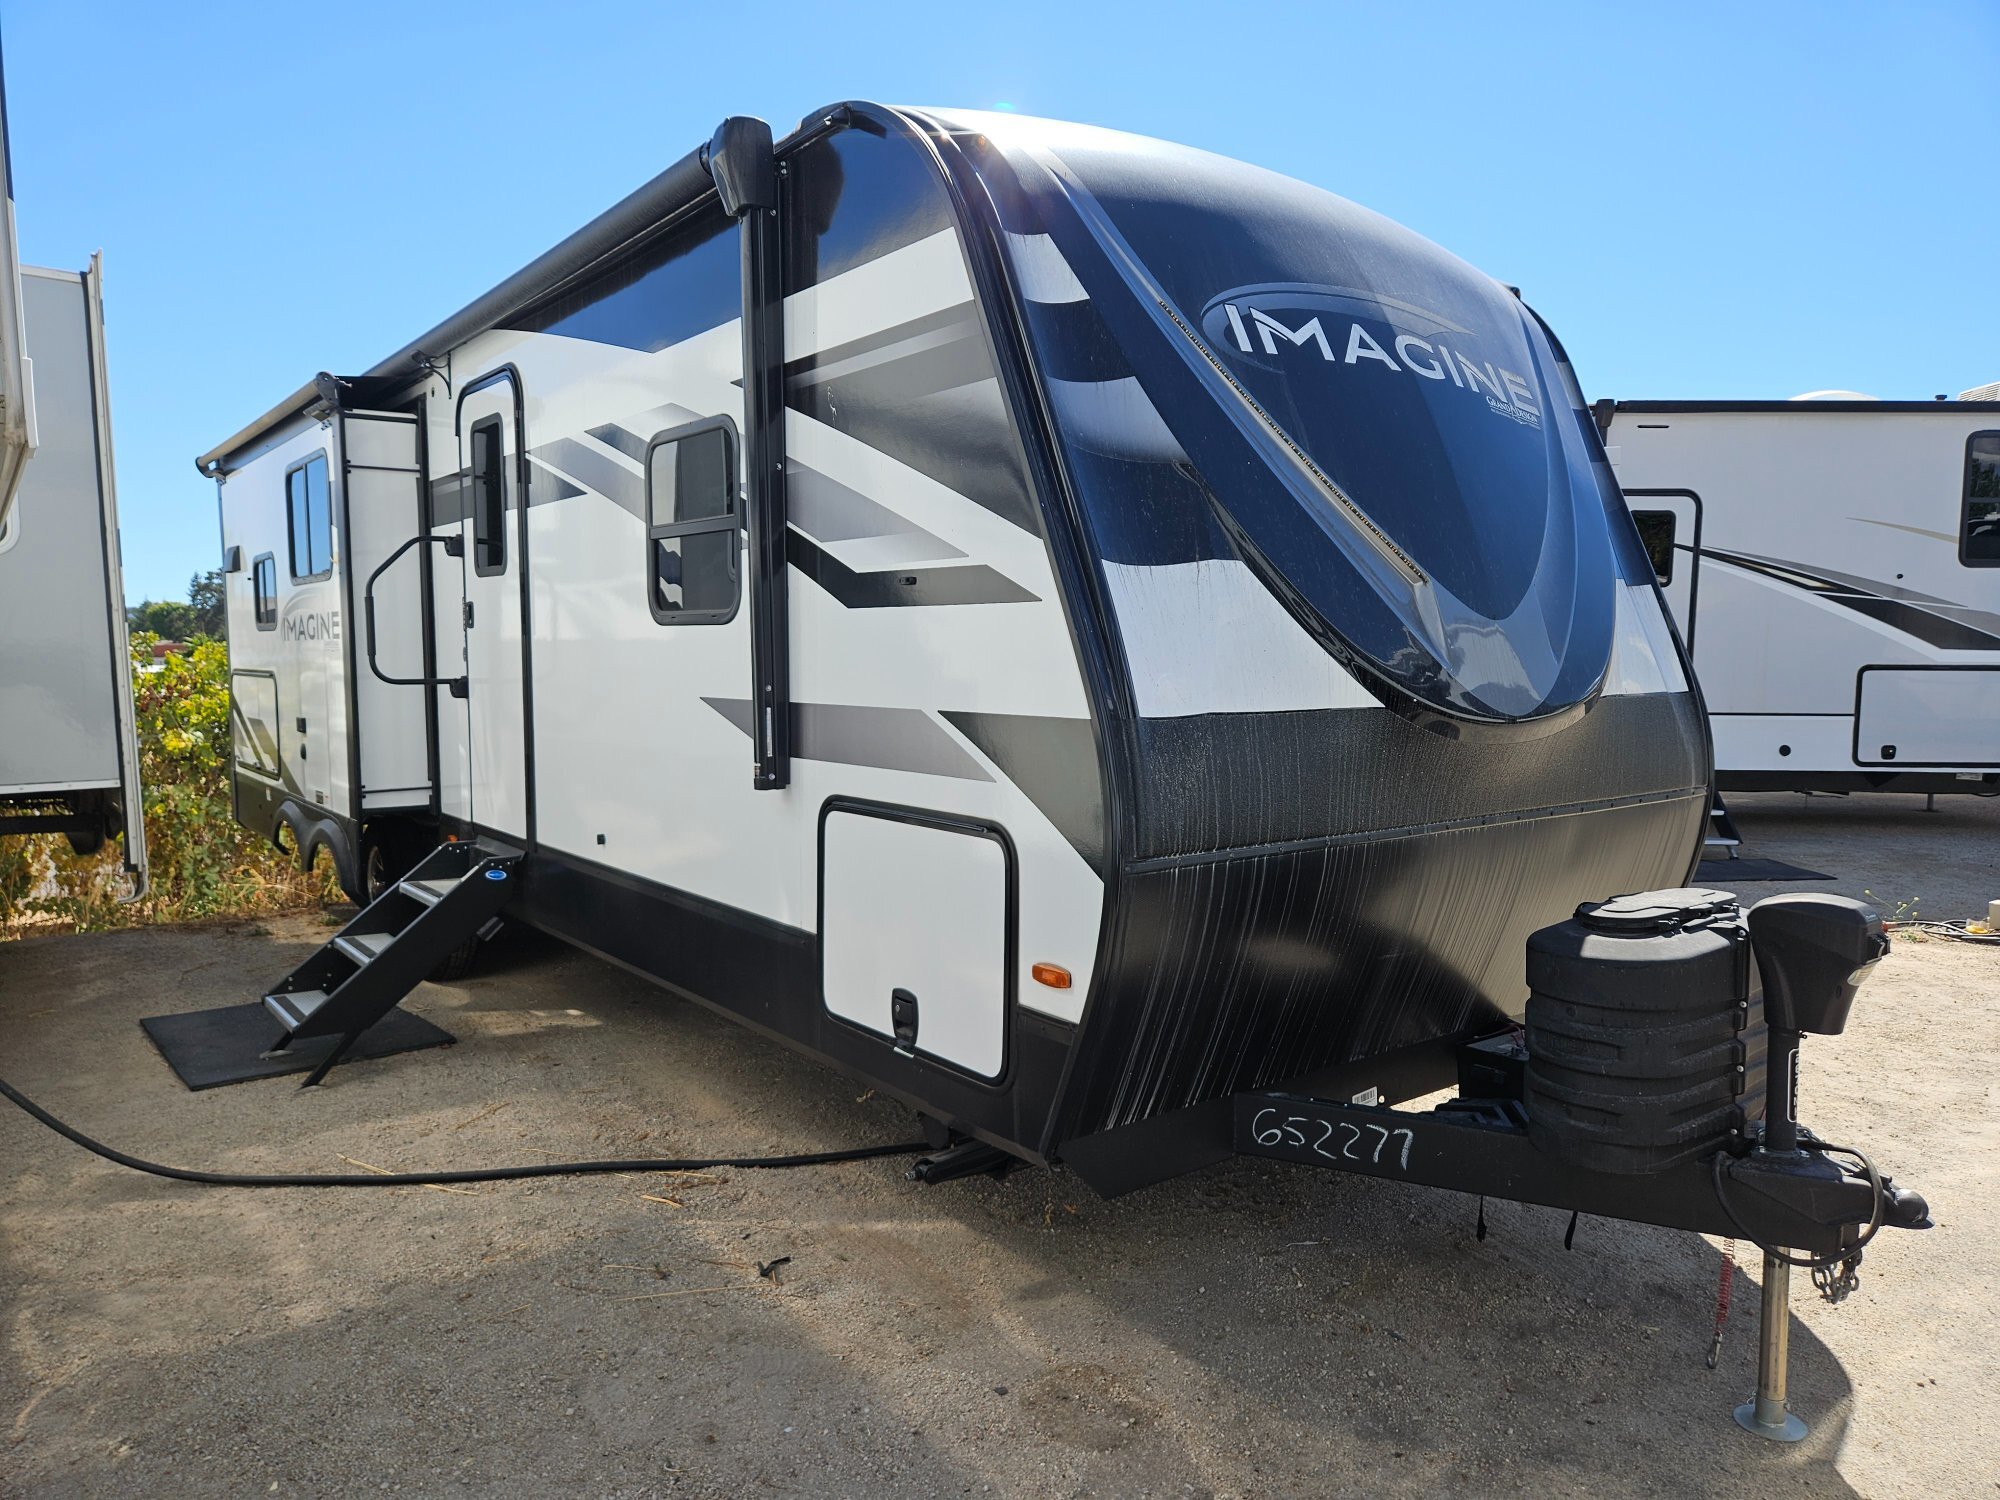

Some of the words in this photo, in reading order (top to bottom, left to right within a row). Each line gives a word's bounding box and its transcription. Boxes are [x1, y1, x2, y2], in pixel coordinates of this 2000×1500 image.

[1224, 303, 1540, 417] IMAGINE
[282, 611, 340, 641] IMAGINE
[1253, 1108, 1414, 1171] 652277
